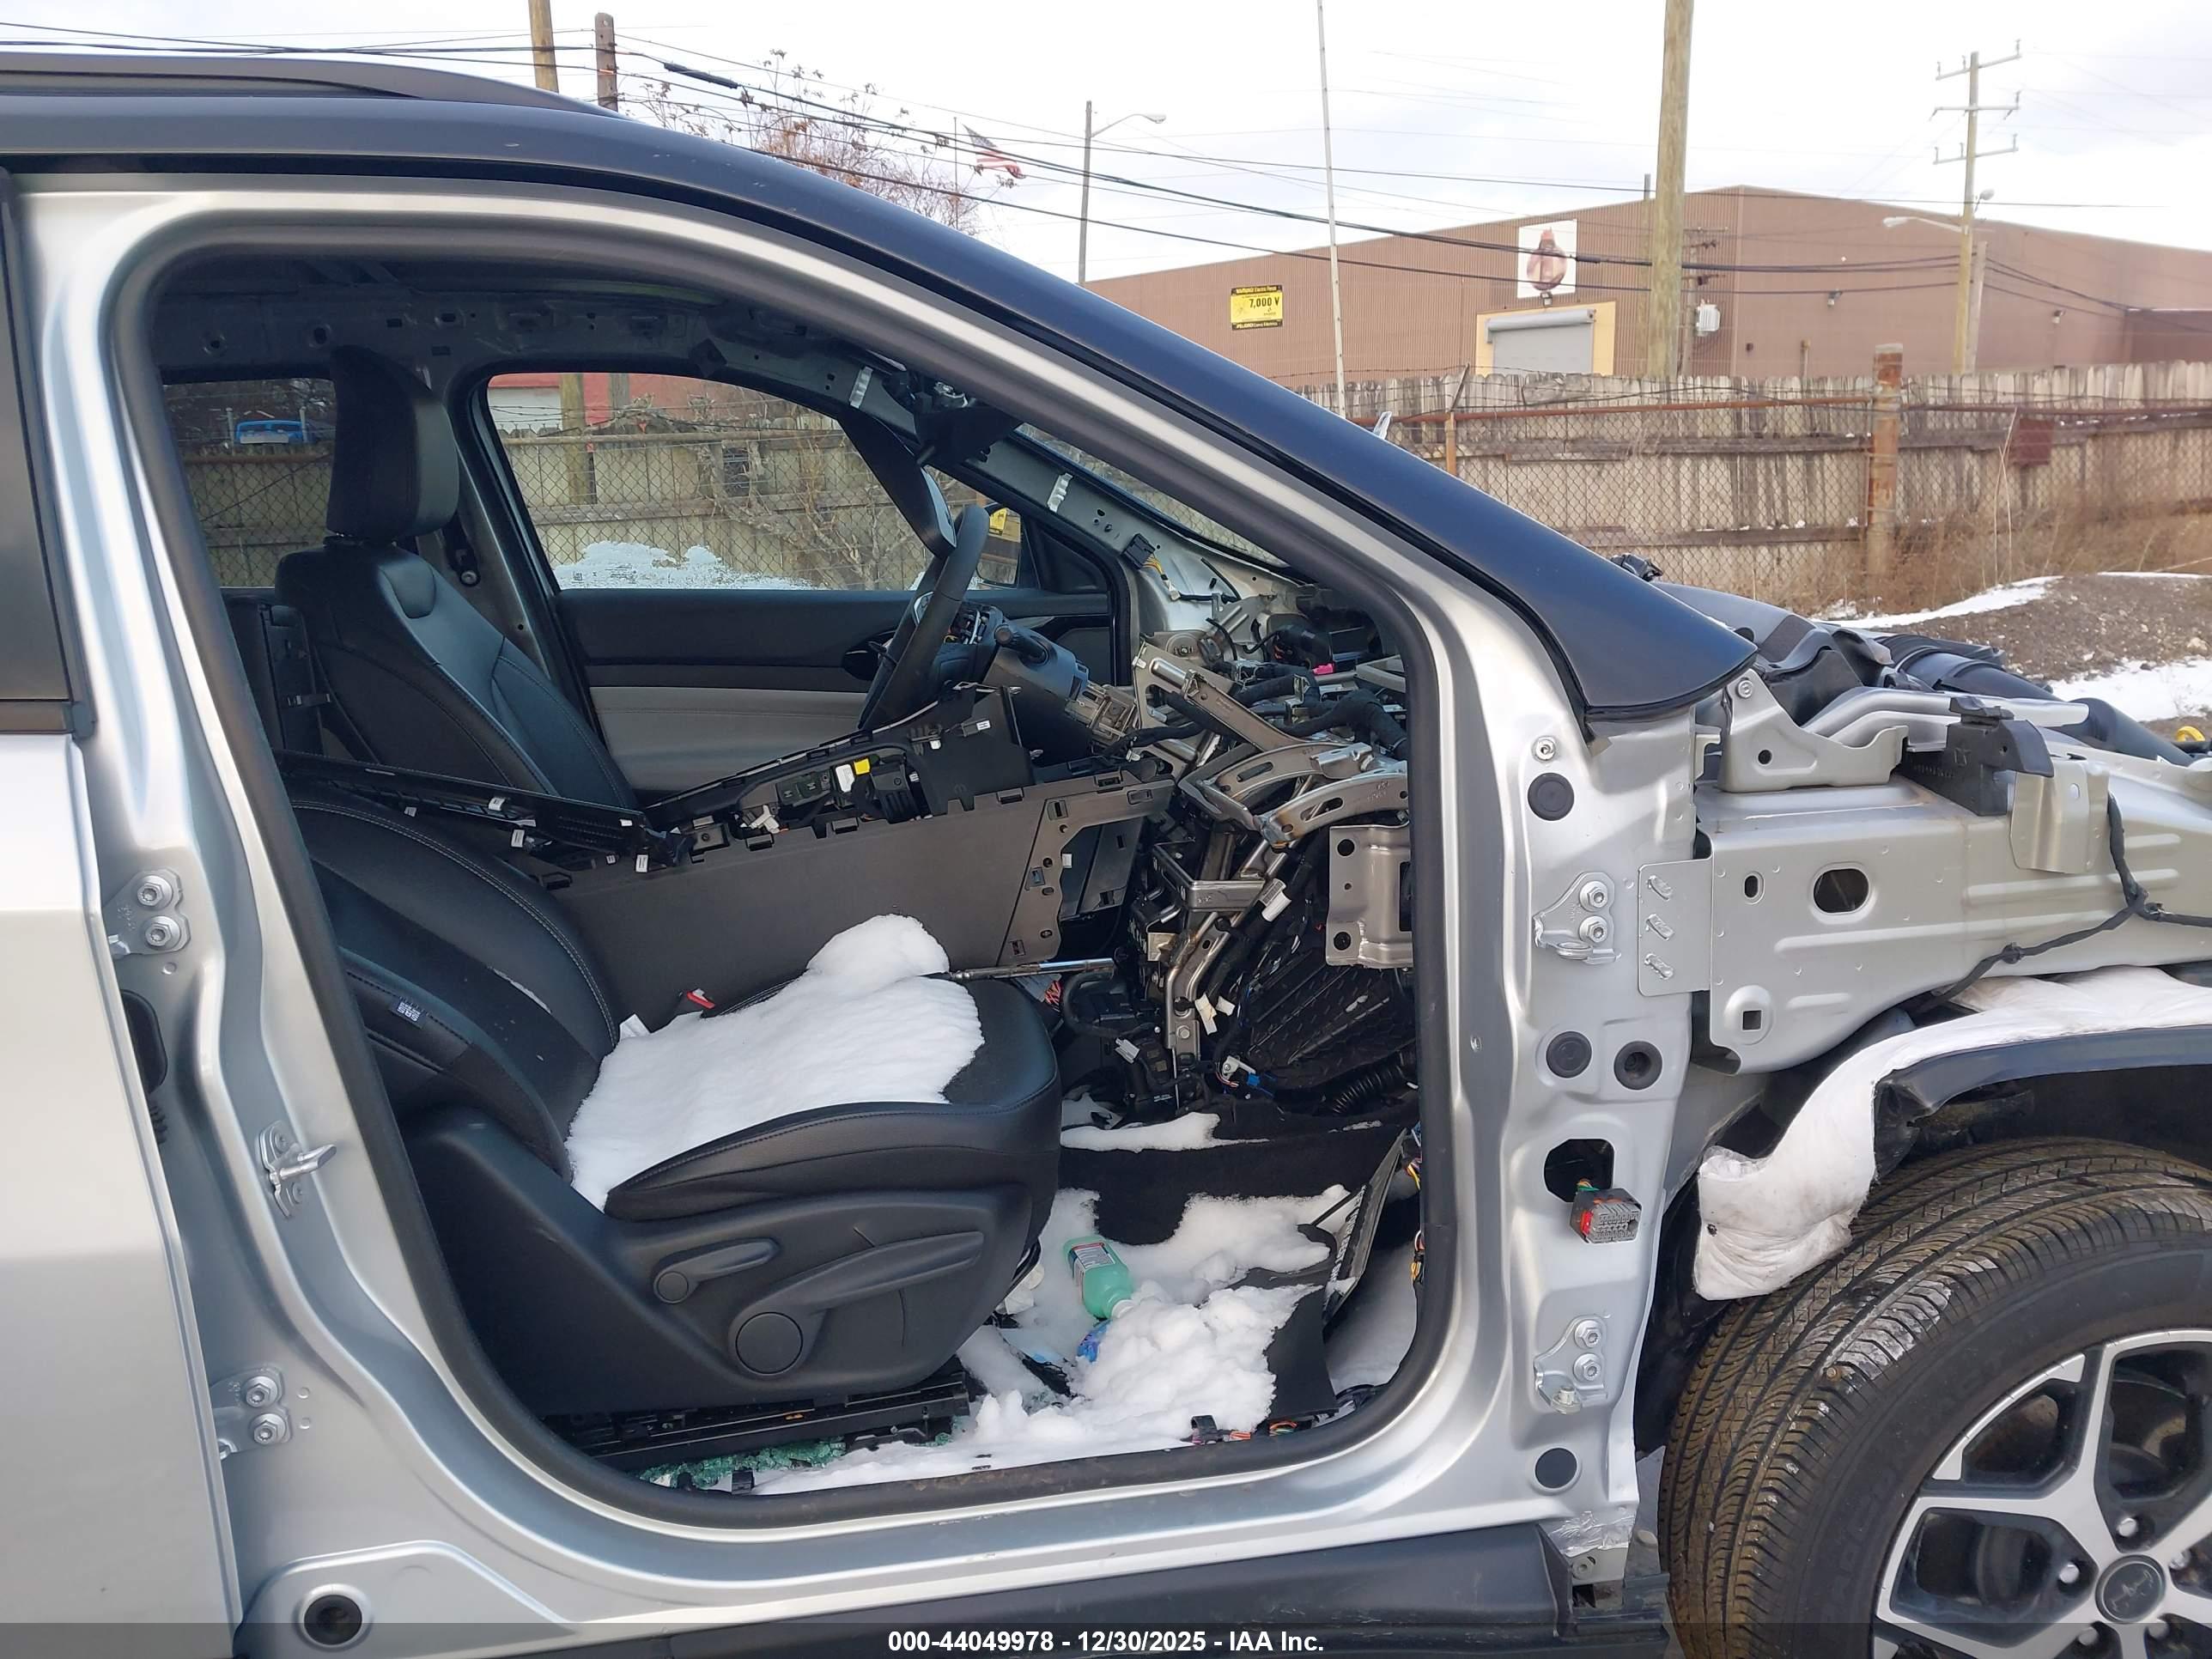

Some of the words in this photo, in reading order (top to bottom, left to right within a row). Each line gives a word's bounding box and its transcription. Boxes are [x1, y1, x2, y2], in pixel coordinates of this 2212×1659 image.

[1249, 297, 1272, 309] 7,000
[1274, 296, 1279, 306] V
[397, 1006, 419, 1022] SRS
